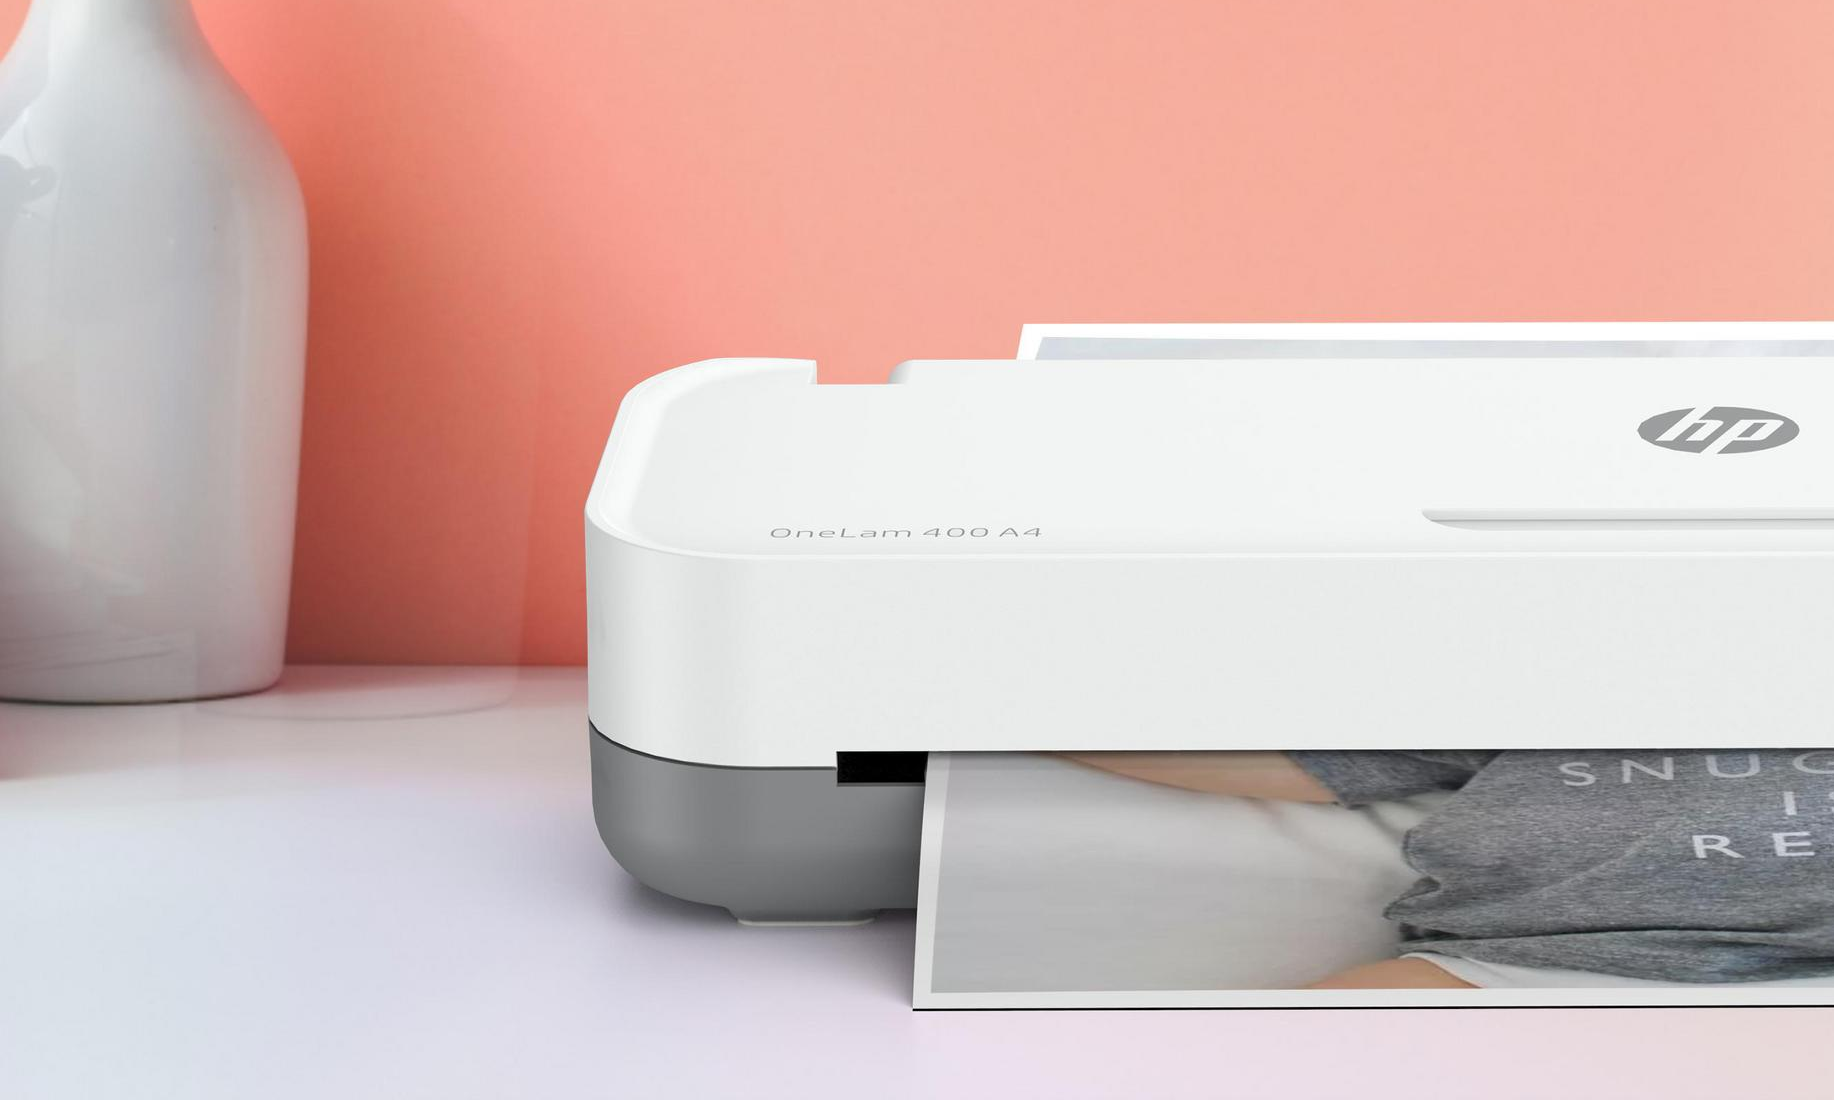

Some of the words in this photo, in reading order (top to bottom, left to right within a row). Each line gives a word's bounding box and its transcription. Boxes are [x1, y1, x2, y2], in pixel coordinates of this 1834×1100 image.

[1655, 406, 1785, 454] hp
[769, 527, 912, 539] OneLam
[921, 527, 989, 538] 400
[998, 527, 1043, 538] A4
